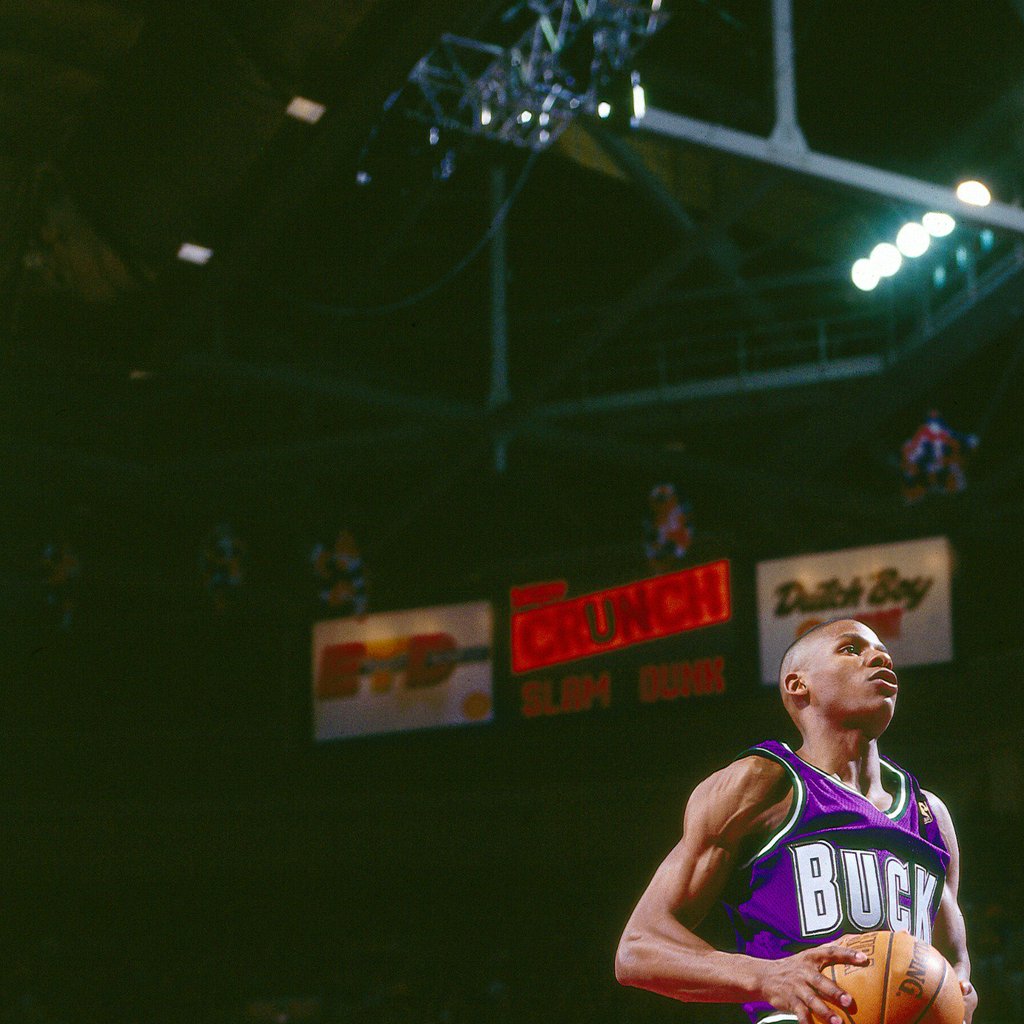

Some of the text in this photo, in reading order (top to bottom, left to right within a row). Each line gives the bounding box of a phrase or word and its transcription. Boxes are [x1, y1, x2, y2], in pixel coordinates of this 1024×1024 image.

[519, 567, 722, 661] CRUNCH
[521, 656, 726, 718] SLAM DUNK
